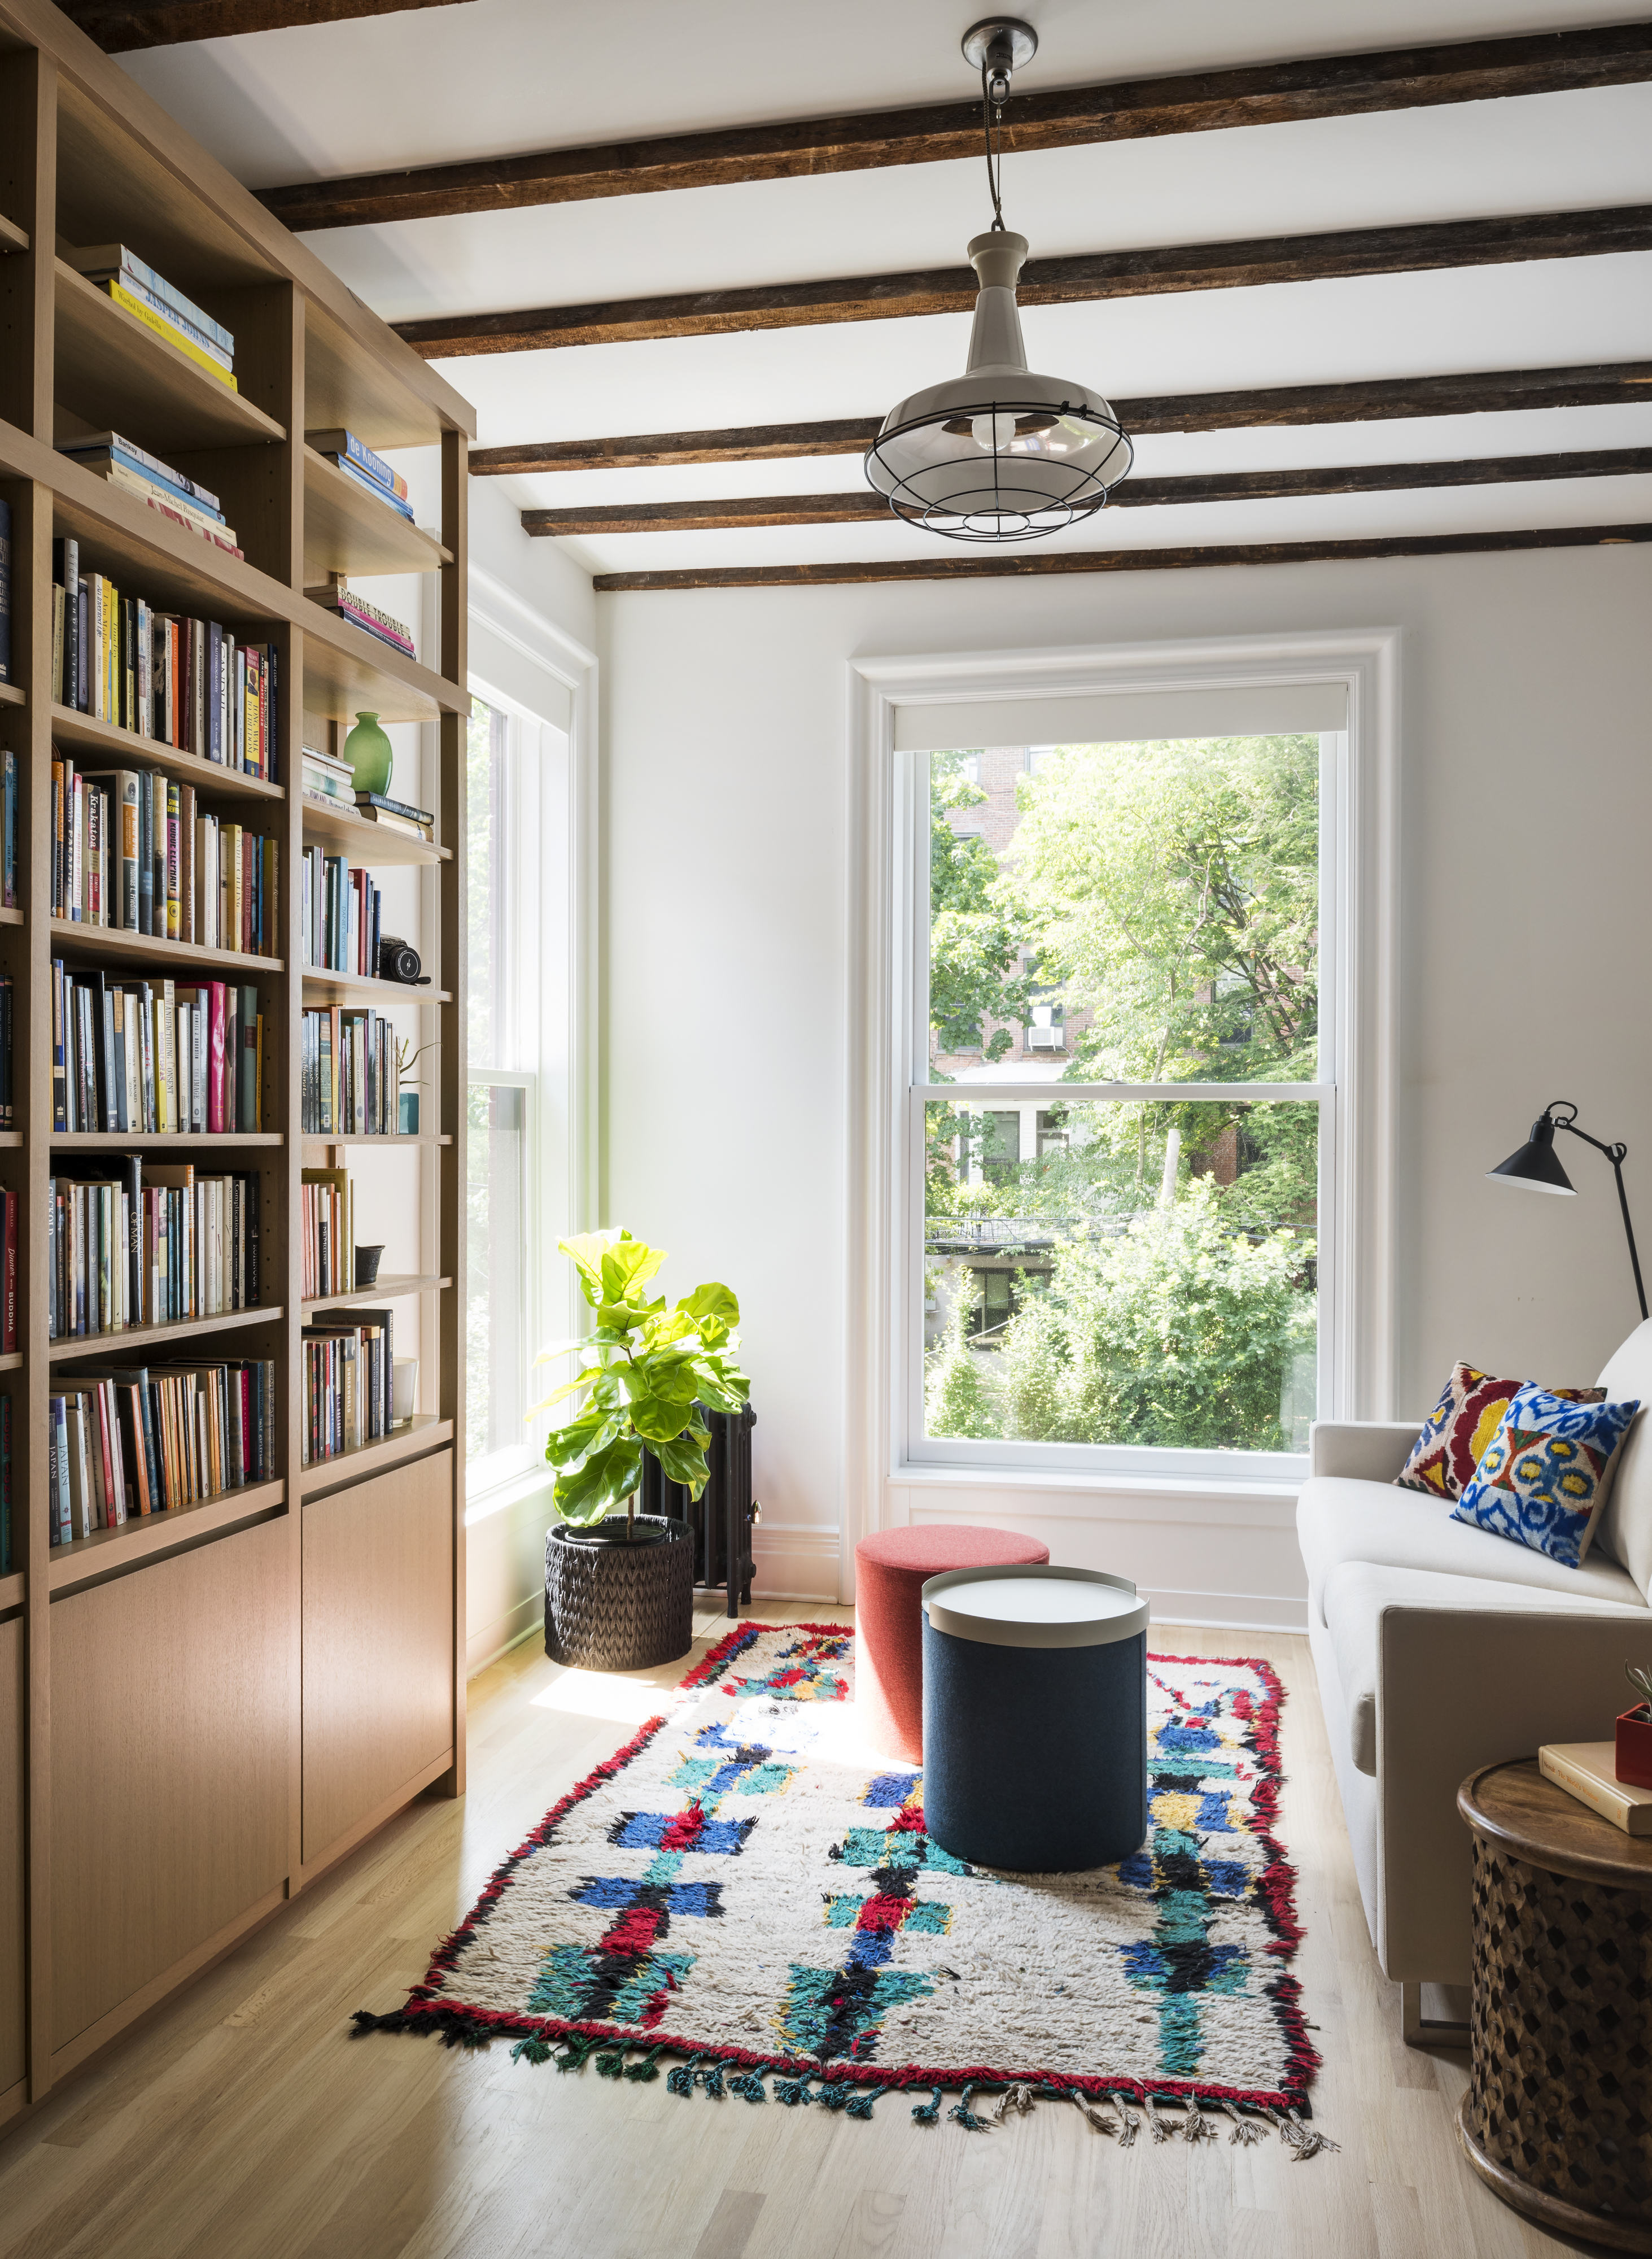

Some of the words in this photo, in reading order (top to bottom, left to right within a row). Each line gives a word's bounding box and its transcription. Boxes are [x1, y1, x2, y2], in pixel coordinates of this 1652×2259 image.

[117, 290, 136, 310] Warhol
[137, 306, 143, 317] by
[145, 311, 161, 330] Galella
[146, 292, 180, 325] JASPER
[182, 320, 210, 348] JOHNS
[118, 437, 137, 455] Banksy
[351, 436, 359, 456] de
[362, 444, 391, 486] Kooning
[151, 485, 182, 509] Jean-Michel
[183, 505, 204, 523] Basquiat
[97, 585, 102, 595] An
[103, 601, 108, 616] Am
[247, 701, 252, 710] TO
[170, 822, 178, 848] ROGUE
[170, 850, 178, 891] ELEPHANT
[131, 1212, 137, 1227] OF
[59, 1445, 69, 1486] JAPAN
[1544, 1761, 1556, 1774] Novak
[1583, 1786, 1599, 1803] Wisdom
